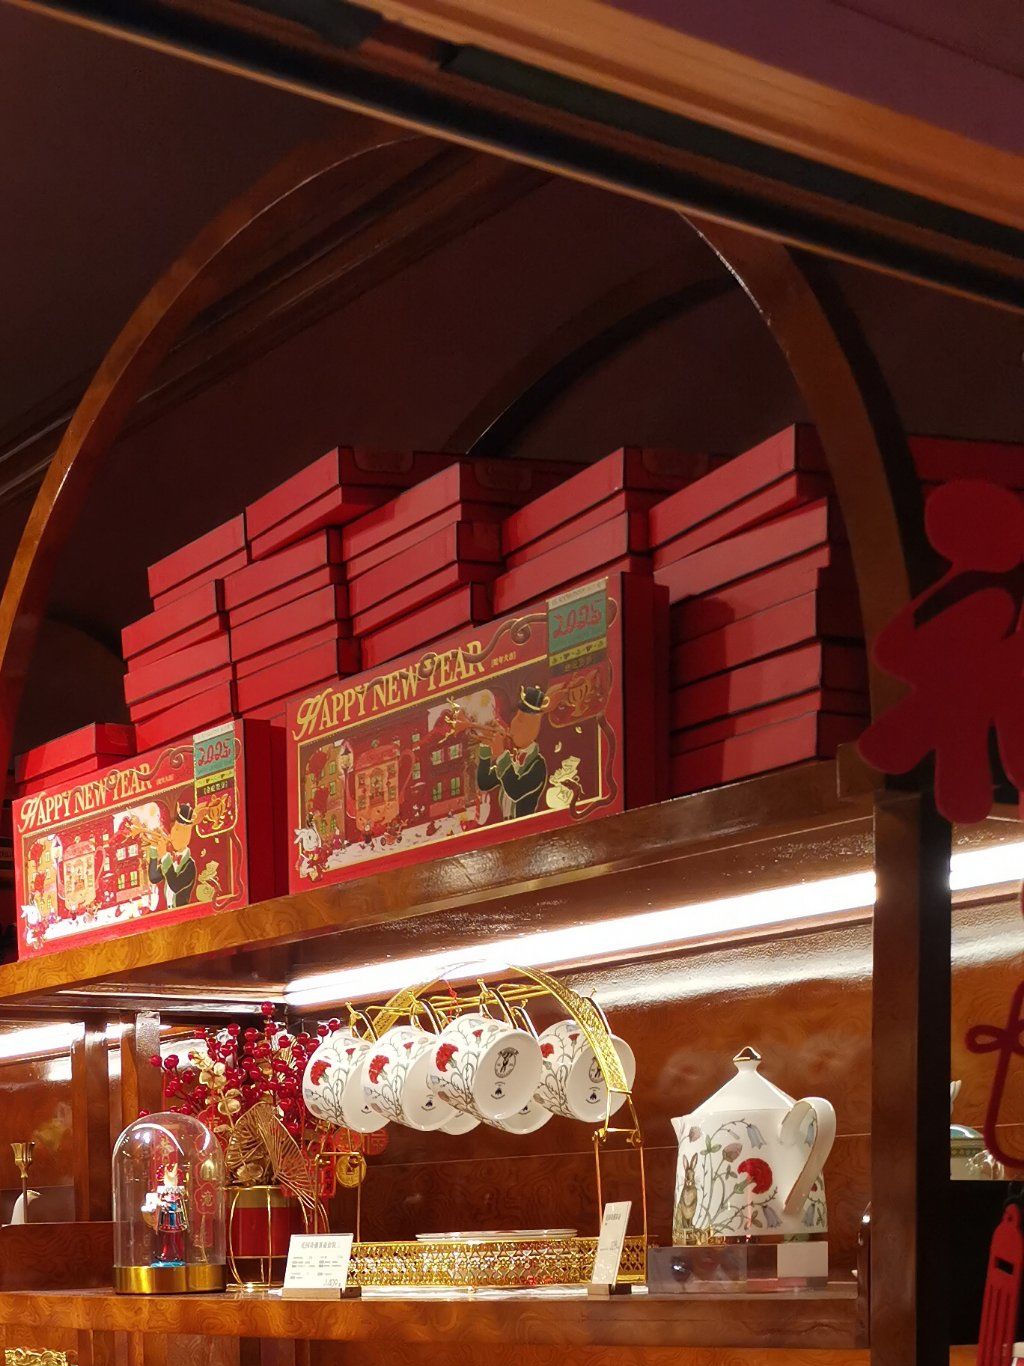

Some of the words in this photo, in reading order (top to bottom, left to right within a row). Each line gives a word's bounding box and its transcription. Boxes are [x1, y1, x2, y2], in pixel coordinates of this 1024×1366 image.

[293, 683, 373, 741] HAPPY
[370, 663, 422, 711] NEW
[420, 641, 485, 692] YEAR
[18, 789, 72, 833] HAPPY
[73, 778, 114, 814] NEW
[110, 763, 153, 802] YEAR
